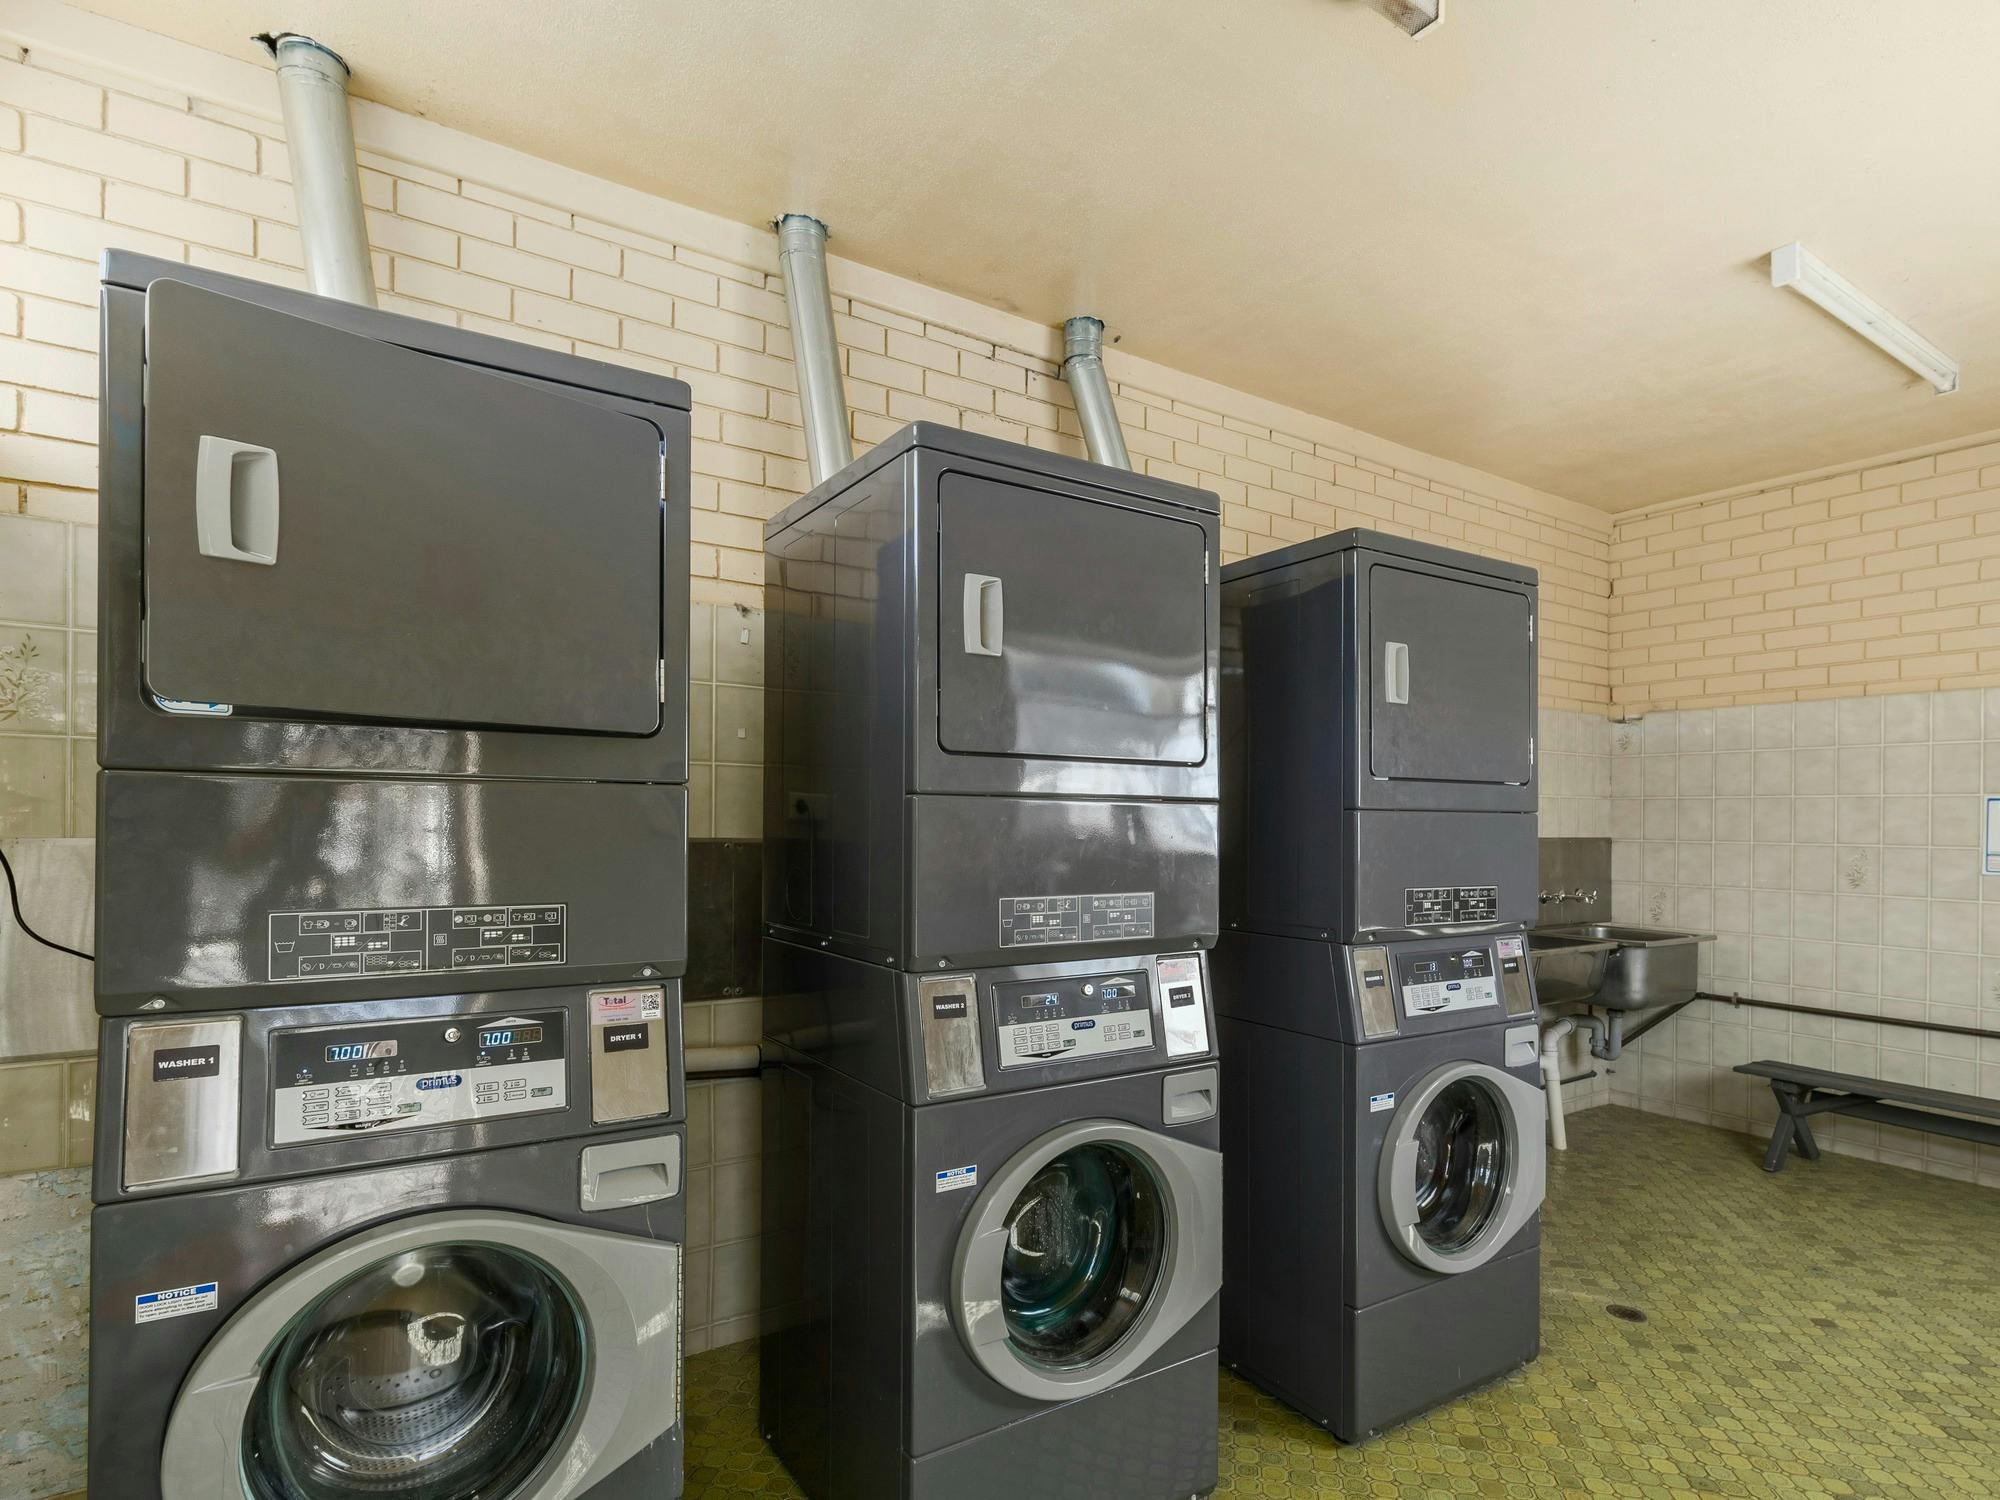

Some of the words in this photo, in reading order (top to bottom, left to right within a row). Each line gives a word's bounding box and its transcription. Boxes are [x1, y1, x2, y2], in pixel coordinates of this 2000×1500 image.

[603, 996, 626, 1006] Total
[1045, 995, 1058, 1005] 24
[1073, 1021, 1094, 1030] primus
[610, 1033, 636, 1042] DRYER
[158, 1058, 206, 1069] WASHER
[422, 1075, 457, 1089] primus
[157, 1288, 197, 1301] NOTICE
